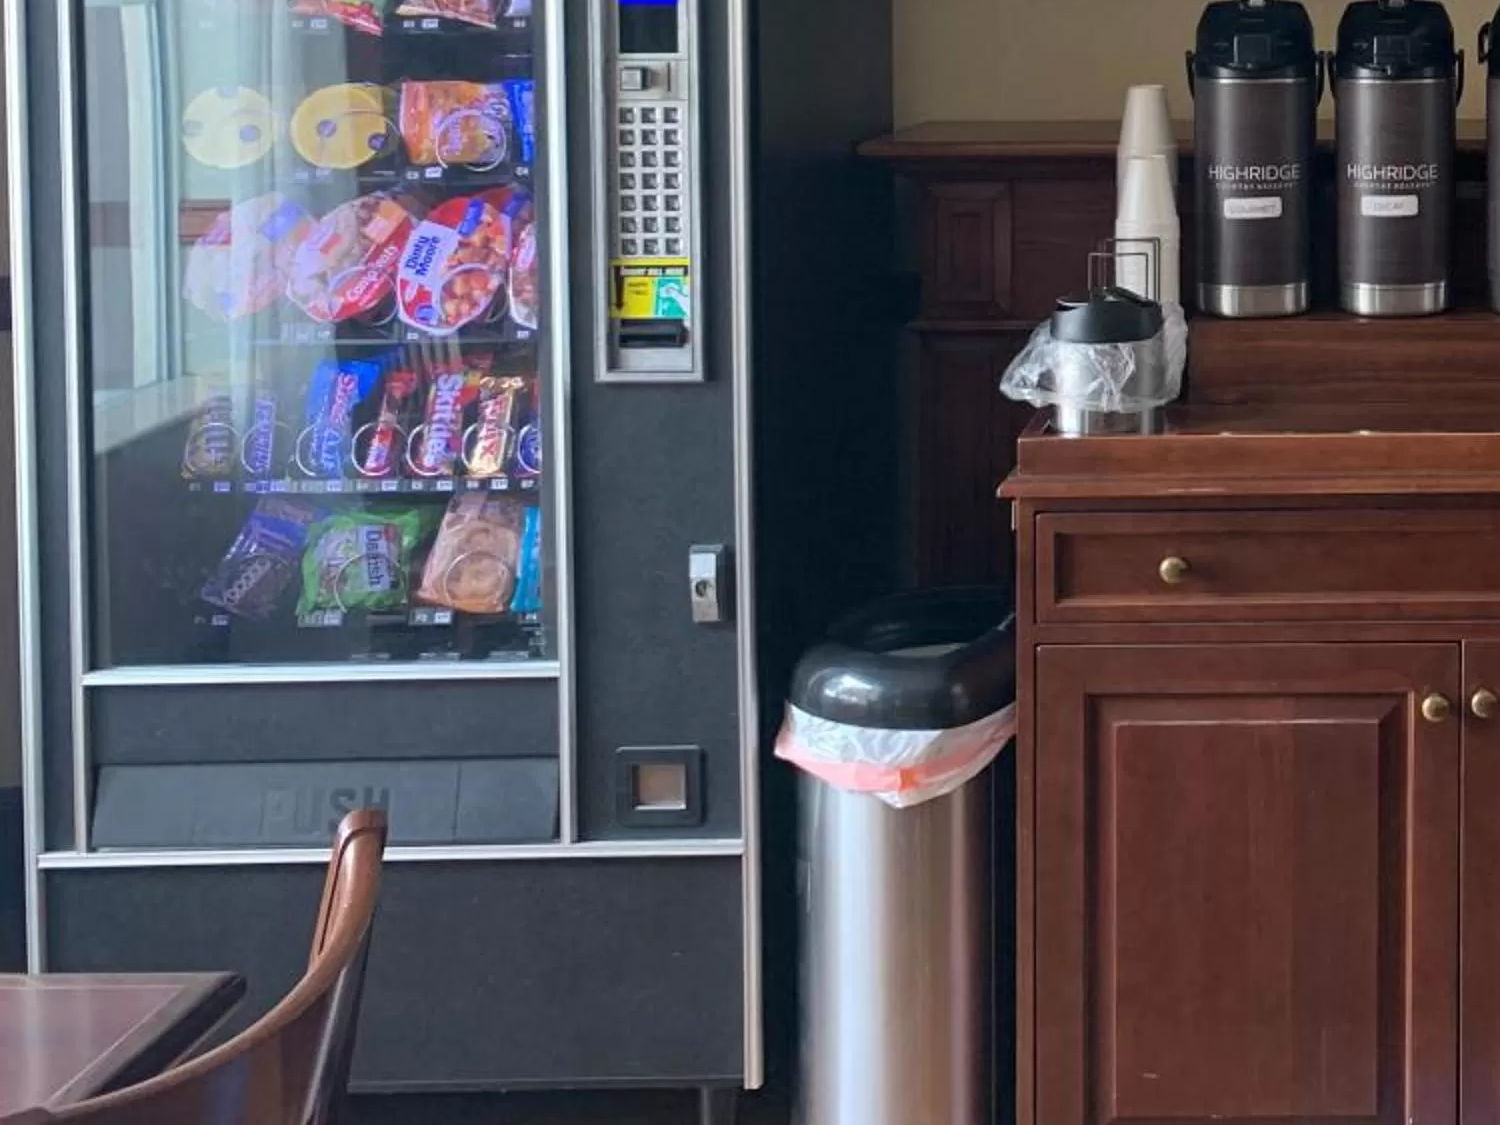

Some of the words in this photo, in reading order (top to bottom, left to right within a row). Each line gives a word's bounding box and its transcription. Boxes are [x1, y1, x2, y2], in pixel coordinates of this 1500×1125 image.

[1208, 164, 1301, 181] HIGHRIDGE
[1347, 164, 1439, 181] HIGHRIDGE
[416, 236, 440, 277] Moore
